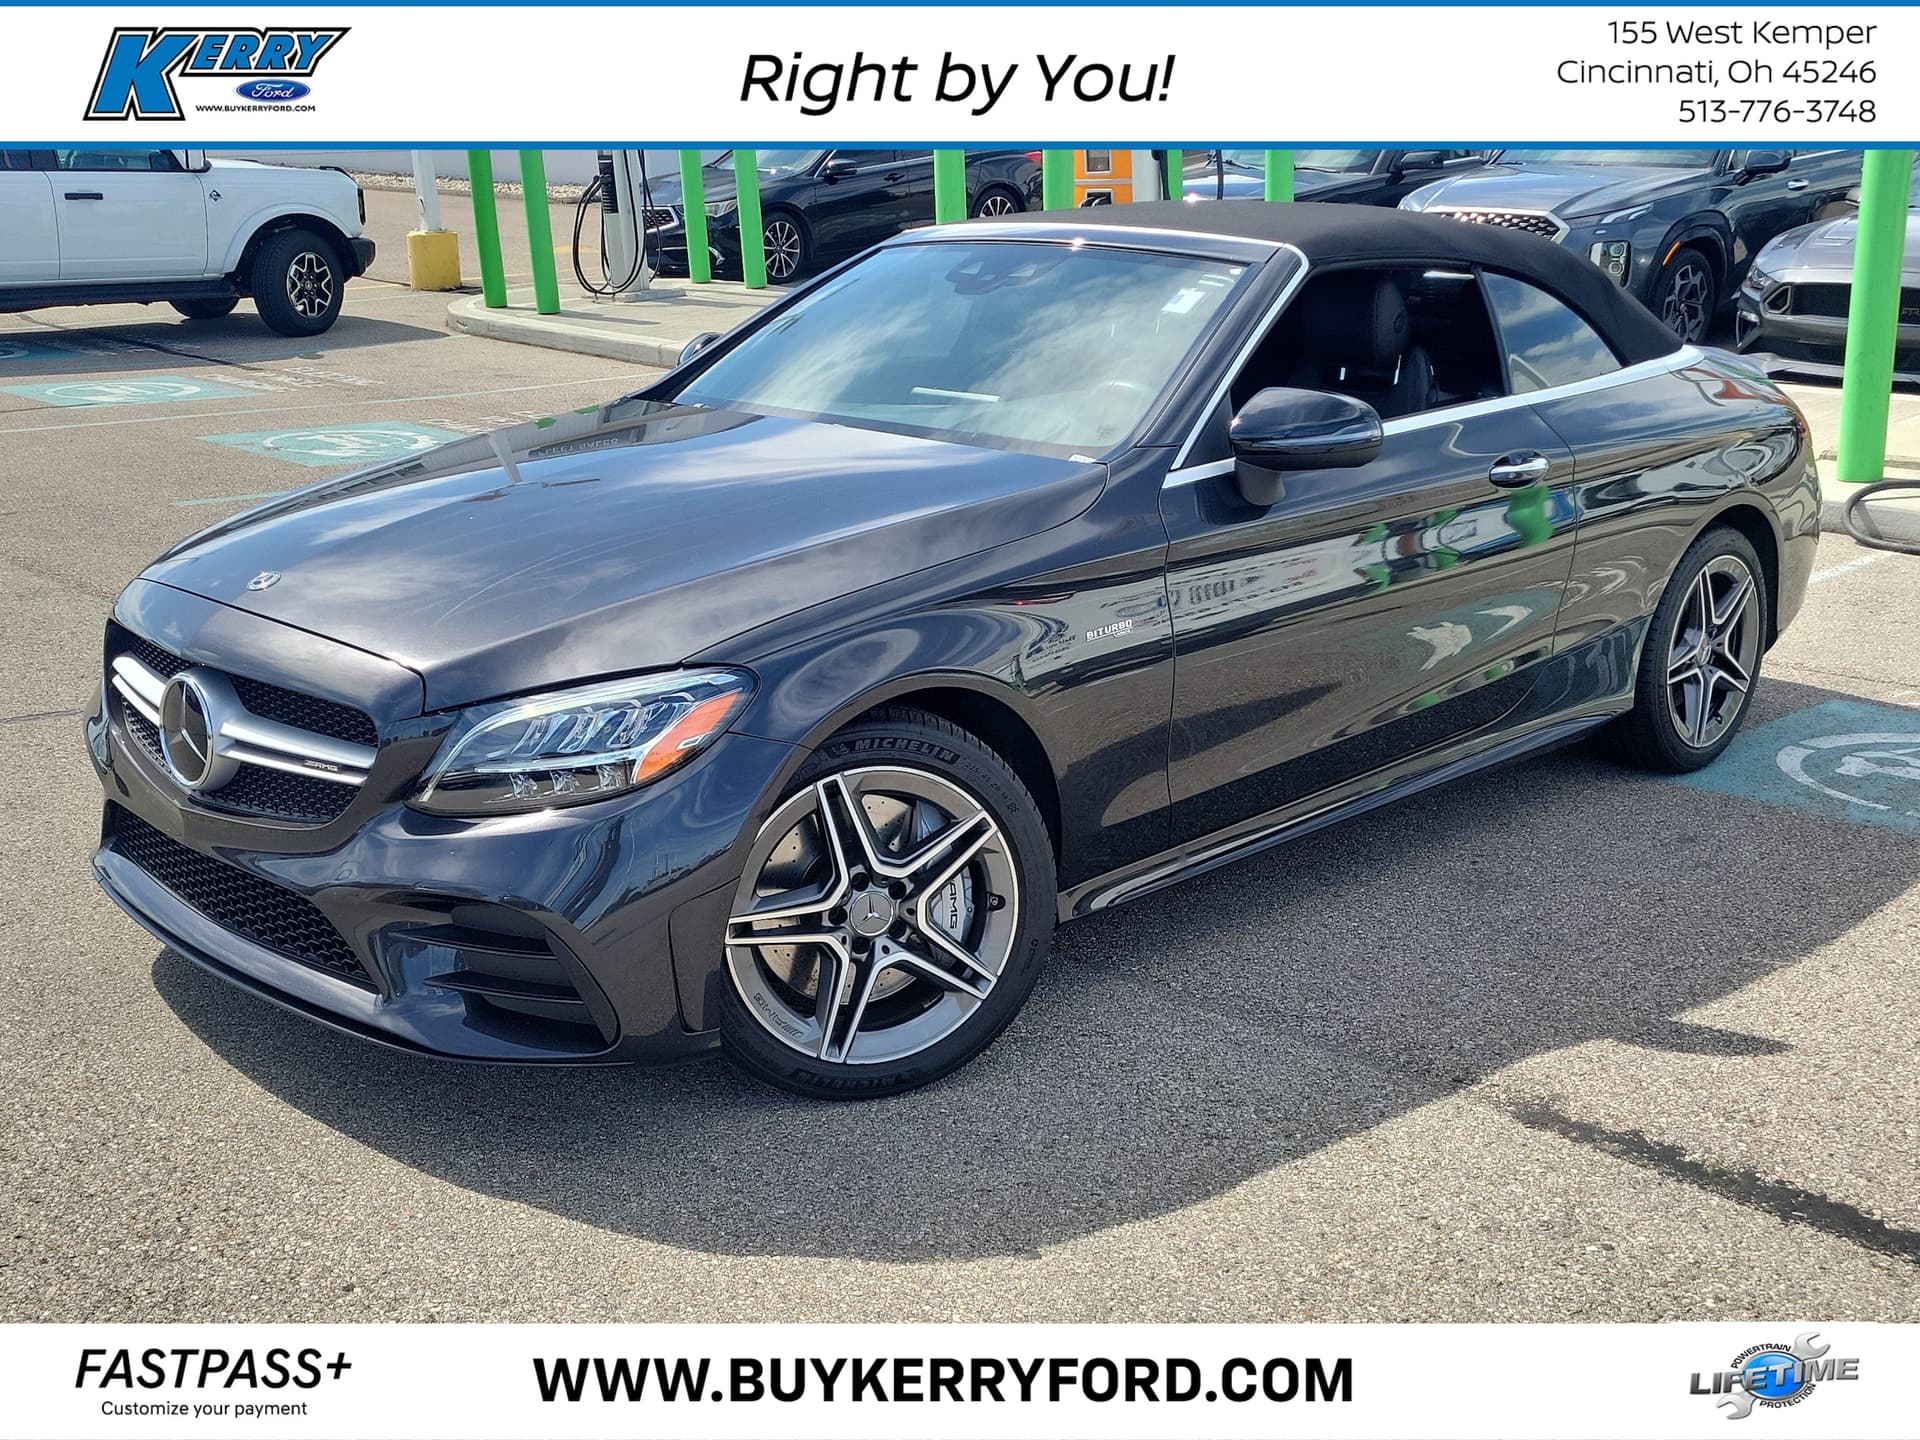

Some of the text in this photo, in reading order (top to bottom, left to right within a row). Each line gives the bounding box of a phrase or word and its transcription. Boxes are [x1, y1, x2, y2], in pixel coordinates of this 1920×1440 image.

[1086, 619, 1132, 640] BITURBO
[855, 737, 955, 763] MICHELIN
[949, 881, 958, 929] AMG
